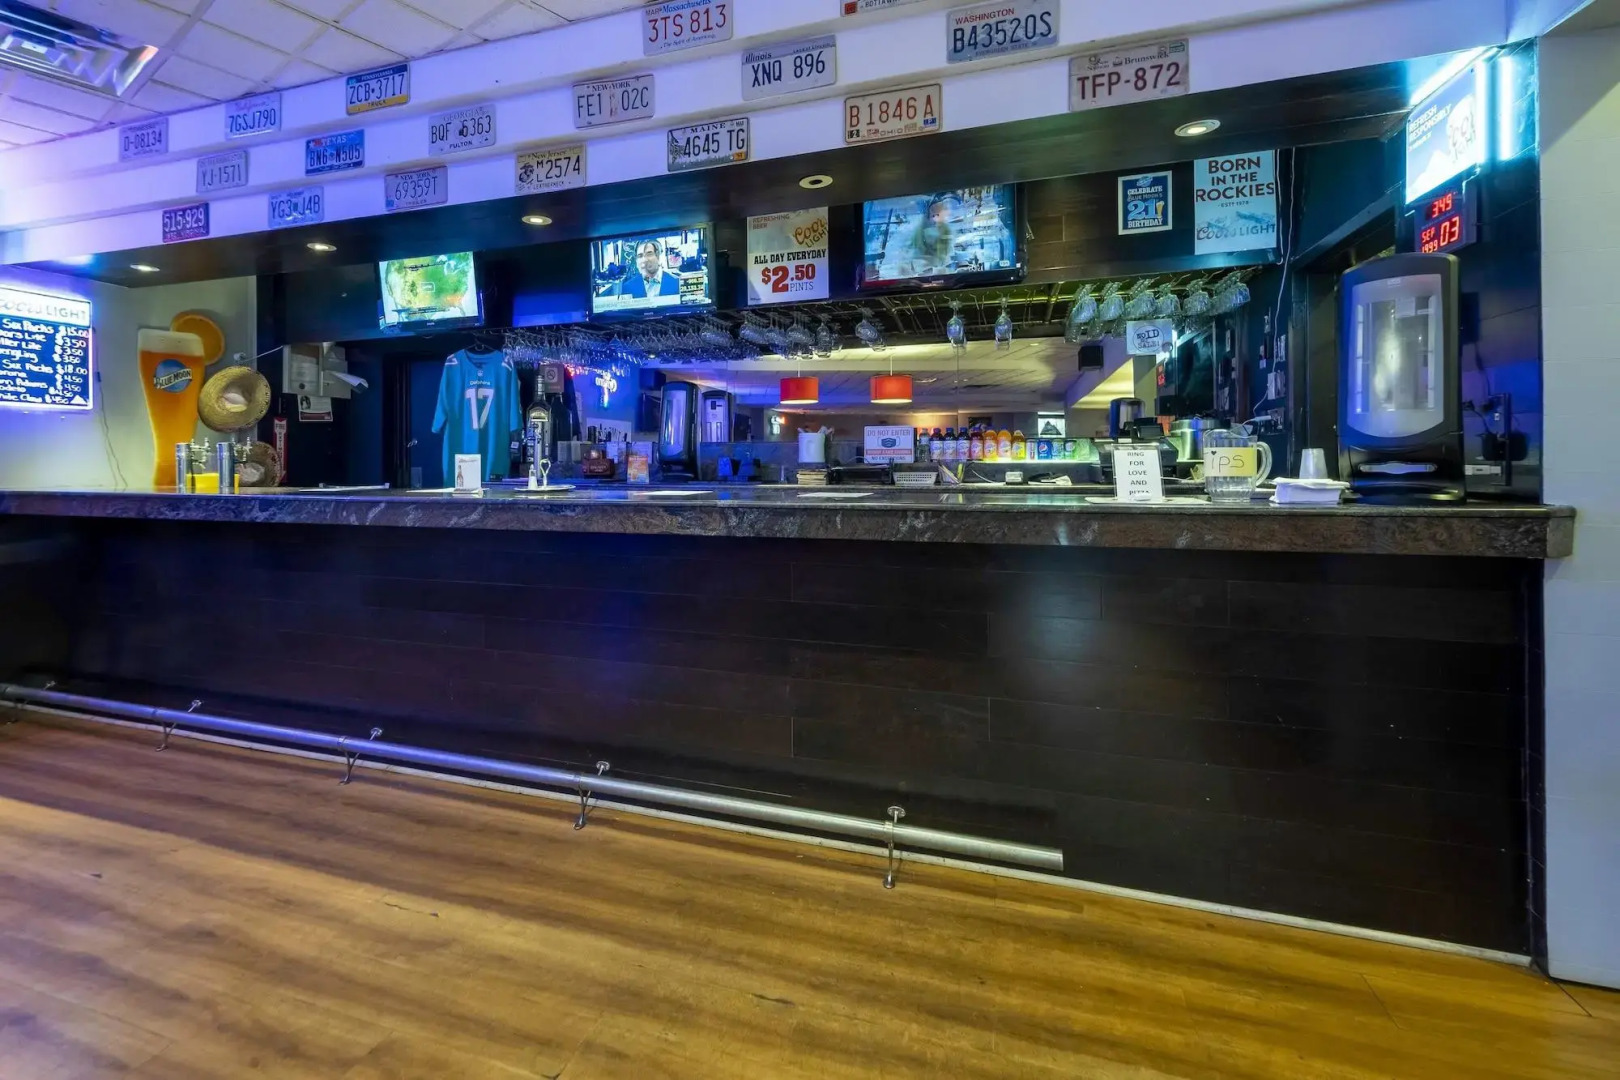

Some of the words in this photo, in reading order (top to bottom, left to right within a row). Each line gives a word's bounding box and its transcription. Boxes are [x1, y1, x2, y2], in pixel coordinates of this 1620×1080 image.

[648, 13, 683, 42] 3TS
[690, 4, 726, 33] 813
[955, 8, 1015, 25] WASHINGTON
[953, 11, 1053, 53] B43520S
[1124, 52, 1169, 66] Brunswick
[752, 60, 782, 88] XNQ
[793, 51, 826, 78] 896
[592, 83, 609, 92] NEW
[1077, 62, 1182, 100] TFP-872
[577, 94, 602, 119] FE1
[621, 87, 649, 111] 02C
[228, 108, 277, 133] 7GSJ790
[431, 122, 452, 144] BQF
[462, 115, 492, 138] 6363
[690, 123, 726, 133] MAINE
[449, 140, 473, 149] FULTON
[684, 132, 720, 158] 4645
[727, 128, 745, 151] TG
[335, 144, 360, 163] N505
[545, 155, 581, 180] 2574
[1208, 156, 1260, 175] BORN
[395, 176, 438, 201] 69359T
[1211, 175, 1226, 187] IN
[1229, 171, 1257, 184] THE
[1127, 185, 1163, 196] CELEBRATE
[1195, 182, 1275, 203] ROCKIES
[752, 213, 790, 224] REFRESHING
[1127, 198, 1156, 220] 21
[752, 222, 768, 230] BEER
[1127, 217, 1163, 229] BIRTHDAY
[1439, 216, 1460, 247] 03
[754, 255, 769, 265] ALL
[770, 253, 785, 263] DAY
[787, 248, 827, 262] EVERYDAY
[790, 281, 814, 292] PINTS
[46, 304, 86, 319] LIGHT
[173, 370, 192, 382] MOON
[465, 388, 495, 430] 17
[1204, 451, 1245, 473] ips
